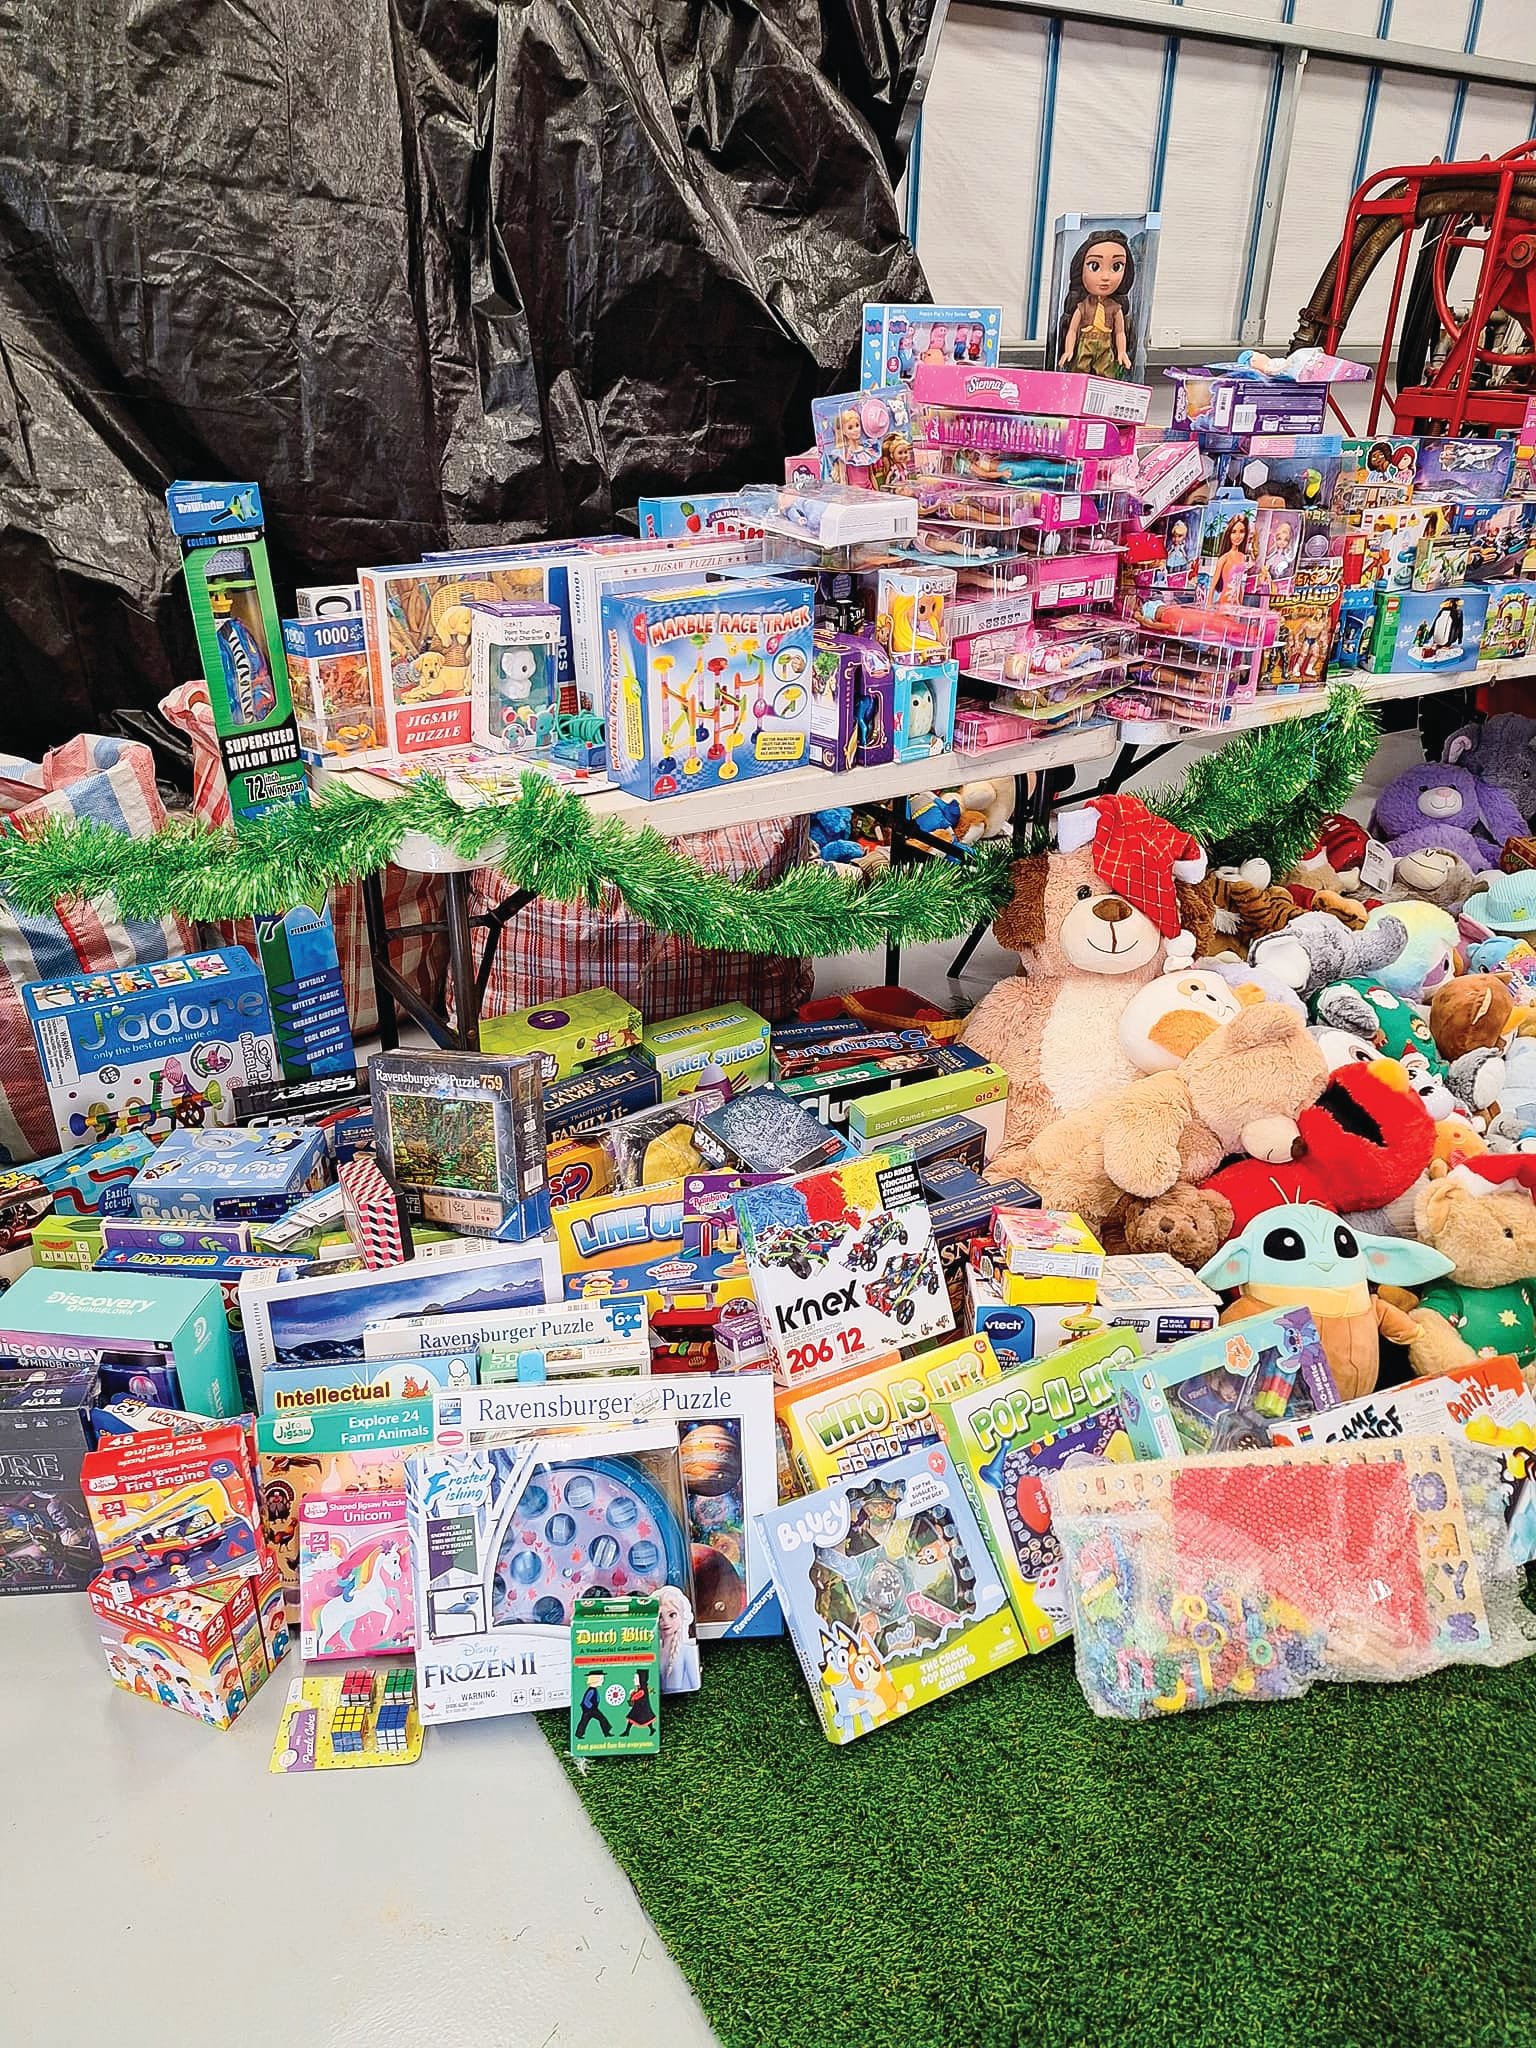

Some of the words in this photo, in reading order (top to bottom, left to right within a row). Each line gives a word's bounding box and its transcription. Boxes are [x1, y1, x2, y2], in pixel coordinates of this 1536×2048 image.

[968, 376, 1002, 393] Sienna
[1475, 508, 1489, 516] CITY
[652, 560, 685, 573] JIGSAW
[688, 556, 723, 569] PUZZLE
[314, 625, 349, 646] 1000
[650, 612, 713, 648] MARBLE
[719, 611, 760, 635] RACE
[763, 605, 812, 636] TRACK
[406, 708, 461, 728] JIGSAW
[225, 727, 295, 755] SUPERSIZED
[405, 725, 462, 745] PUZZLE
[228, 750, 268, 772] NYLON
[245, 775, 266, 802] 72
[264, 771, 280, 785] inch
[265, 780, 304, 799] Wingspan
[292, 1015, 318, 1029] DURABLE
[318, 1006, 345, 1020] AIRFRAME
[304, 1033, 319, 1044] COOL
[319, 1026, 341, 1039] DESIGN
[598, 1033, 608, 1042] 15
[833, 1036, 901, 1053] SECOND
[899, 1029, 928, 1048] 5
[94, 1049, 114, 1060] only
[115, 1045, 131, 1056] the
[132, 1042, 153, 1053] best
[153, 1039, 167, 1049] for
[168, 1035, 184, 1046] the
[185, 1032, 205, 1042] little
[306, 1049, 325, 1061] READY
[325, 1046, 334, 1054] TO
[334, 1042, 344, 1052] FLY
[787, 1044, 832, 1059] RULE
[665, 1053, 712, 1080] TRICK
[714, 1038, 766, 1067] STICKS
[376, 1070, 441, 1089] Ravensburger
[449, 1075, 480, 1091] Puzzle
[480, 1074, 503, 1091] 759
[544, 1085, 601, 1111] GAME
[600, 1070, 639, 1089] SET
[550, 1079, 597, 1099] FAMILY
[570, 1103, 609, 1121] TRADITIONS
[875, 1117, 898, 1131] Board
[899, 1111, 925, 1123] Games
[551, 1112, 608, 1142] FAMILY
[878, 1171, 894, 1181] RAD
[893, 1165, 913, 1177] RIDES
[689, 1192, 728, 1208] Rainbow
[571, 1204, 648, 1257] LINE
[164, 1255, 218, 1265] KNOCK
[45, 1290, 157, 1313] Discovery
[776, 1276, 861, 1333] k'nex
[985, 1318, 1021, 1331] vtech
[1159, 1317, 1168, 1328] 2
[419, 1326, 537, 1350] Ravensburger
[541, 1318, 595, 1337] Puzzle
[742, 1334, 762, 1346] anko
[0, 1340, 104, 1366] iscovery
[786, 1337, 834, 1374] 206
[836, 1327, 865, 1355] 12
[275, 1380, 391, 1410] Intellectual
[479, 1392, 634, 1422] Ravensburger
[662, 1386, 732, 1412] Puzzle
[809, 1388, 891, 1449] WHO
[891, 1379, 931, 1423] IS
[930, 1351, 984, 1405] IT?
[1447, 1370, 1495, 1424] PARTY!
[349, 1413, 400, 1431] Explore
[402, 1410, 420, 1426] 24
[176, 1436, 203, 1446] Fire
[276, 1426, 312, 1441] Jigsaw
[341, 1429, 375, 1446] Farm
[377, 1424, 430, 1441] Animals
[123, 1442, 174, 1458] Engine
[118, 1469, 152, 1483] Shaped
[152, 1464, 180, 1478] Jigsaw
[181, 1459, 209, 1472] Puzzle
[212, 1463, 229, 1474] $5
[125, 1479, 154, 1493] Fire
[156, 1469, 206, 1486] Engine
[424, 1468, 490, 1504] Frosted
[911, 1483, 924, 1493] POP
[104, 1502, 122, 1512] 24
[329, 1502, 357, 1512] Shaped
[357, 1500, 381, 1511] Jigsaw
[381, 1499, 406, 1507] Puzzle
[909, 1499, 922, 1509] ROLL
[343, 1510, 392, 1523] Unicorn
[776, 1495, 850, 1552] BLUEY
[312, 1534, 327, 1543] 24
[232, 1586, 250, 1611] 48
[90, 1591, 159, 1628] PUZZLE
[732, 1586, 777, 1635] Ravensburge
[176, 1628, 200, 1645] 48
[206, 1615, 225, 1639] 48
[575, 1627, 617, 1647] Dutch
[621, 1625, 655, 1645] Blitz
[459, 1642, 499, 1657] Disney
[424, 1656, 516, 1689] FROZEN
[520, 1652, 538, 1677] II
[920, 1672, 940, 1688] POP
[939, 1653, 977, 1681] AROUND
[461, 1689, 499, 1701] WARNING:
[513, 1694, 525, 1704] 4+
[304, 1713, 316, 1737] Cubes
[302, 1737, 315, 1764] Puzzle
